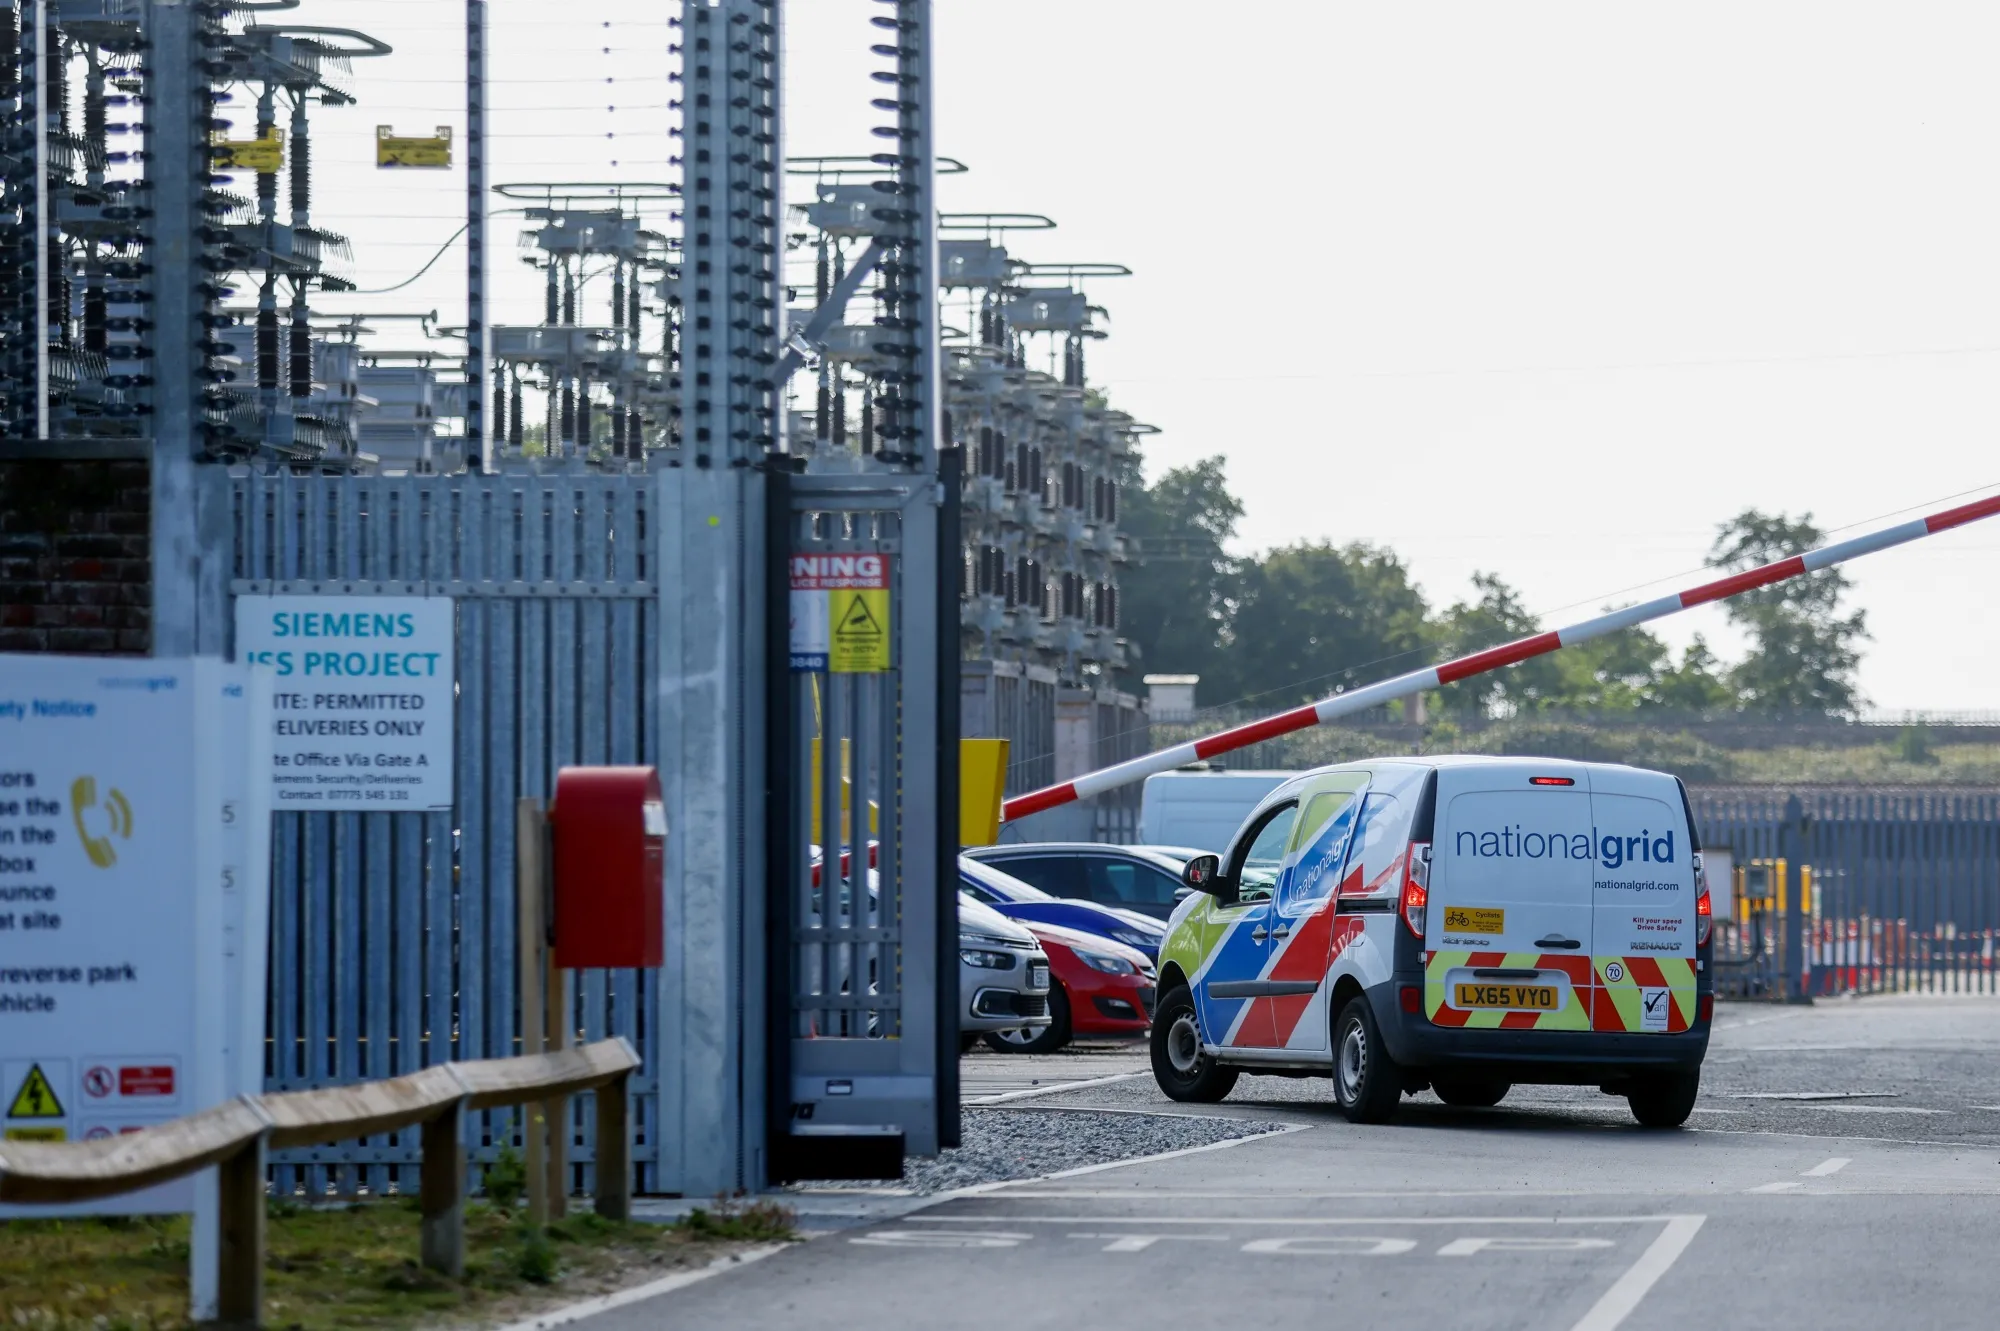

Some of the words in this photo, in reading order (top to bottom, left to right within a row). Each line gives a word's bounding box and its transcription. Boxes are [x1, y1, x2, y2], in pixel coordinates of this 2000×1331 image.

[790, 556, 882, 577] NING
[790, 578, 817, 588] LICE
[820, 578, 883, 588] RESPONSE
[273, 612, 415, 638] SIEMENS
[304, 651, 441, 677] PROJECT
[0, 698, 26, 722] ety
[32, 697, 97, 718] Notice
[272, 693, 308, 710] ITE:
[314, 693, 425, 710] PERMITTED
[274, 720, 369, 736] ELIVERIES
[374, 720, 425, 736] ONLY
[293, 752, 341, 767] Office
[345, 753, 371, 767] Via
[375, 753, 412, 767] Gate
[416, 753, 429, 767] A
[273, 774, 313, 785] iemens
[279, 789, 323, 800] Contact
[26, 796, 61, 816] the
[21, 825, 57, 845] the
[1456, 824, 1675, 869] nationalgrid
[1594, 879, 1679, 892] nationalgrid.com
[21, 910, 62, 931] site
[1475, 911, 1501, 919] Cyclists
[1656, 925, 1678, 933] Safely
[1630, 942, 1683, 951] RENAULT
[0, 966, 82, 984] reverse
[87, 962, 137, 988] park
[1608, 968, 1620, 978] 70
[1462, 987, 1511, 1005] LX65
[1516, 989, 1551, 1007] VYO
[847, 1229, 1616, 1257] STOP
